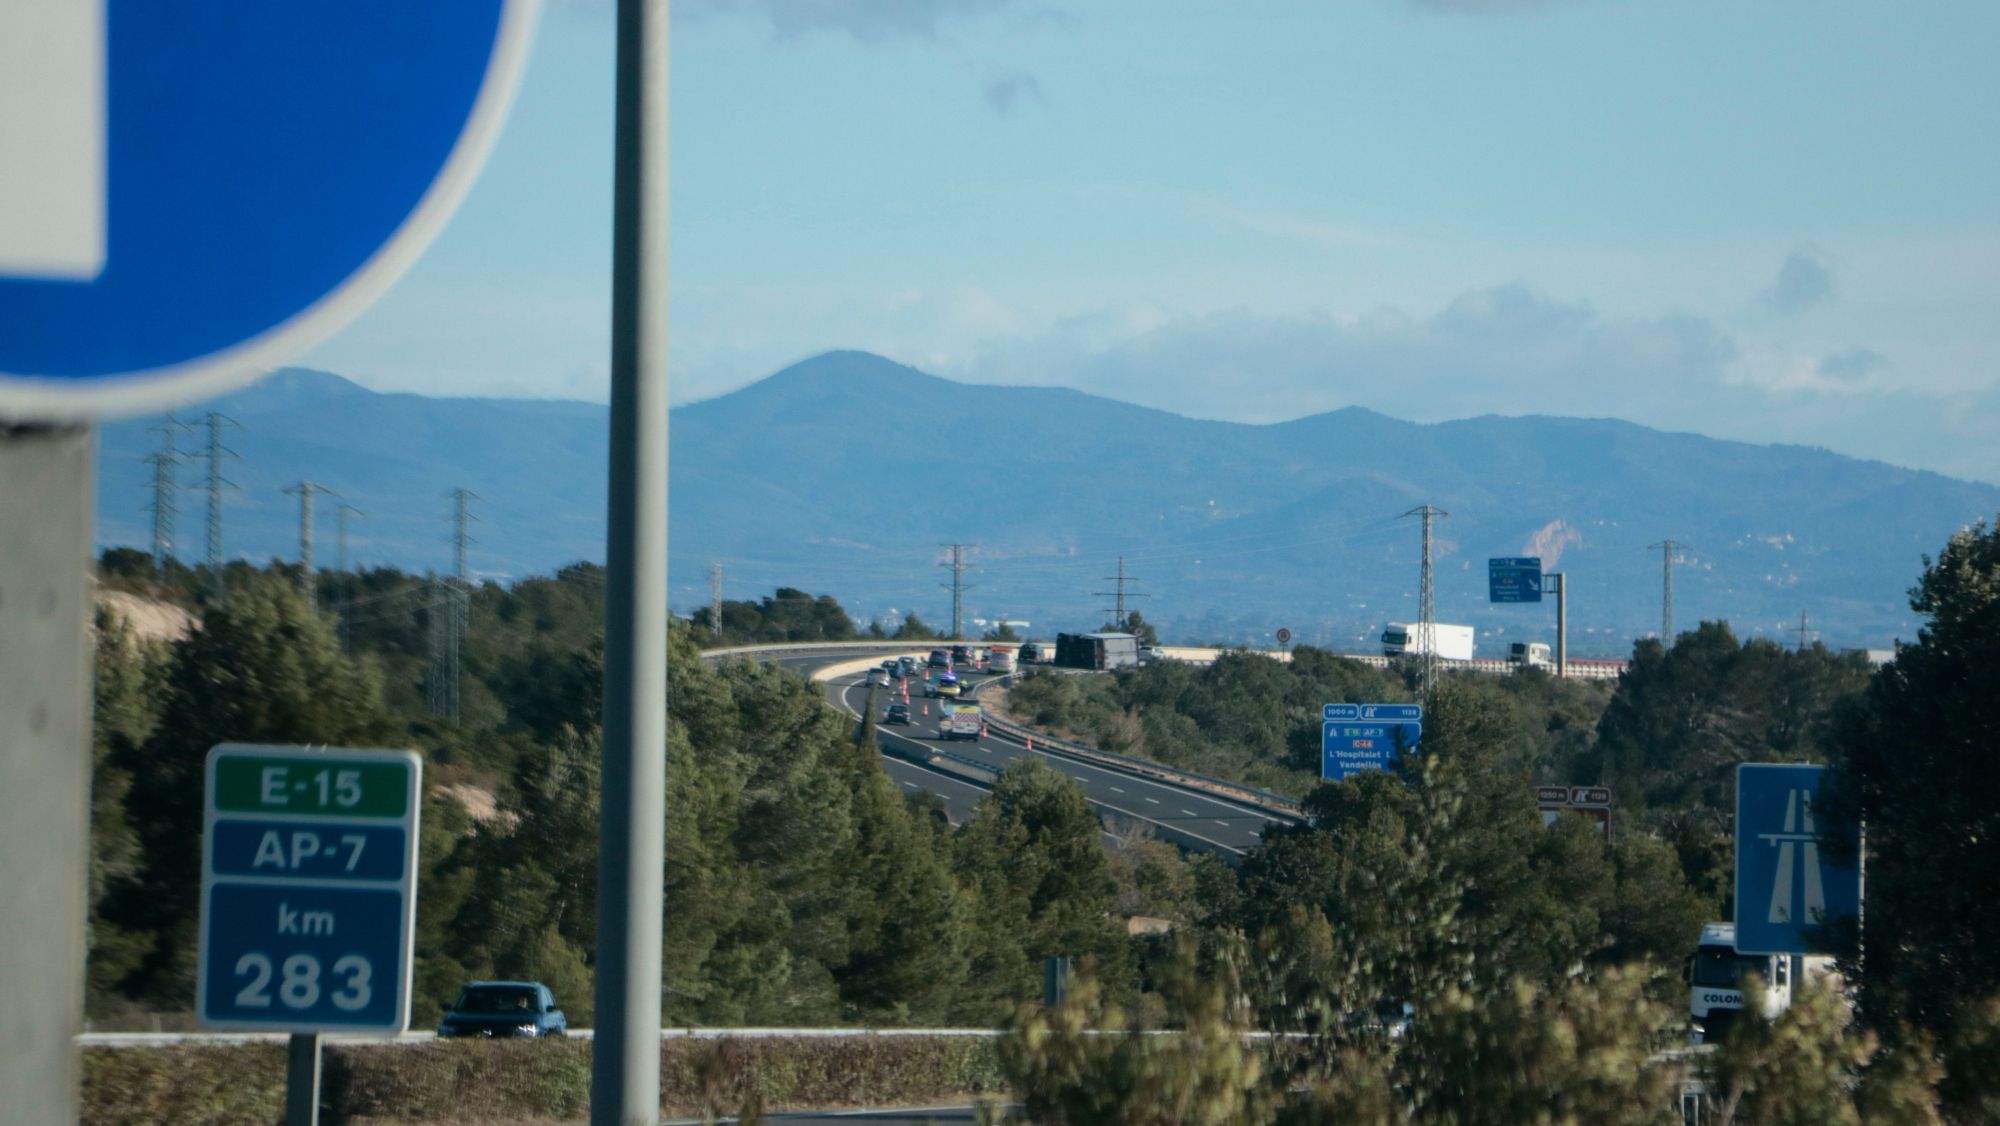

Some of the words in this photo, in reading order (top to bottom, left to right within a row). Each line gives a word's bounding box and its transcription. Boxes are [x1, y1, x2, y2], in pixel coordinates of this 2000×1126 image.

[1329, 750, 1381, 759] L'Hospitalet
[260, 767, 362, 807] E-15
[253, 830, 367, 872] AP-7
[277, 902, 335, 935] km
[234, 953, 373, 1011] 283
